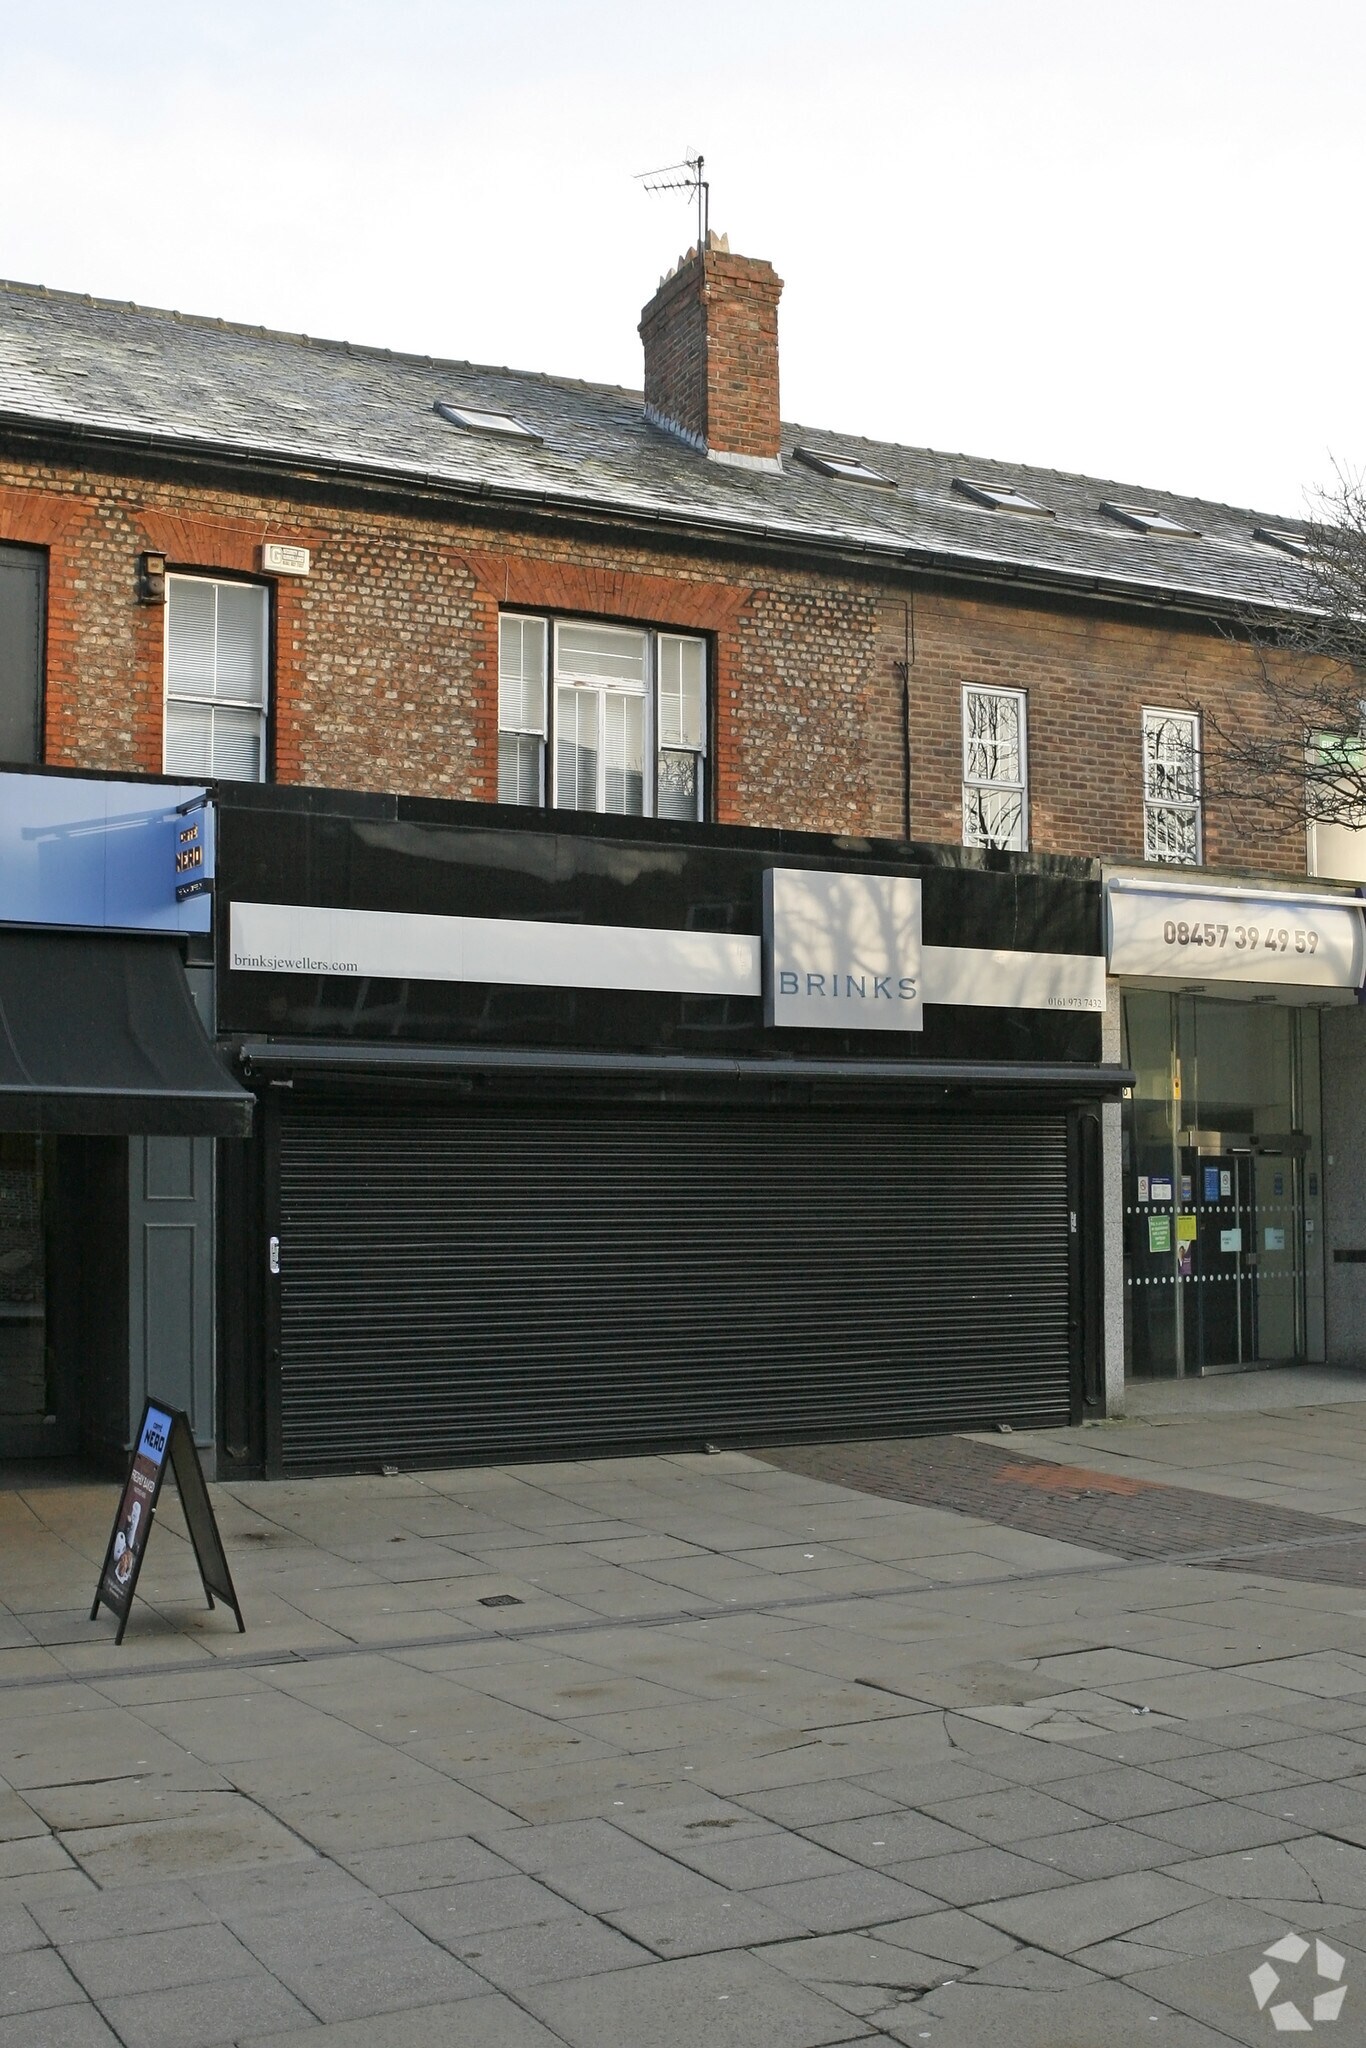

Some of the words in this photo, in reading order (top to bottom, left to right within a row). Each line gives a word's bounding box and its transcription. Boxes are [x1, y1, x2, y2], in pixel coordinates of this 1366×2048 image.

[176, 846, 203, 873] NERO
[1163, 920, 1229, 948] 08457
[1234, 926, 1260, 950] 39
[1264, 928, 1290, 952] 49
[1295, 930, 1319, 954] 59
[234, 953, 358, 972] brinksjewellers.com
[780, 971, 917, 1000] BRINKS
[1048, 997, 1066, 1006] 0161
[1068, 998, 1082, 1007] 973
[1084, 998, 1102, 1008] 7432
[144, 1429, 166, 1453] NERO
